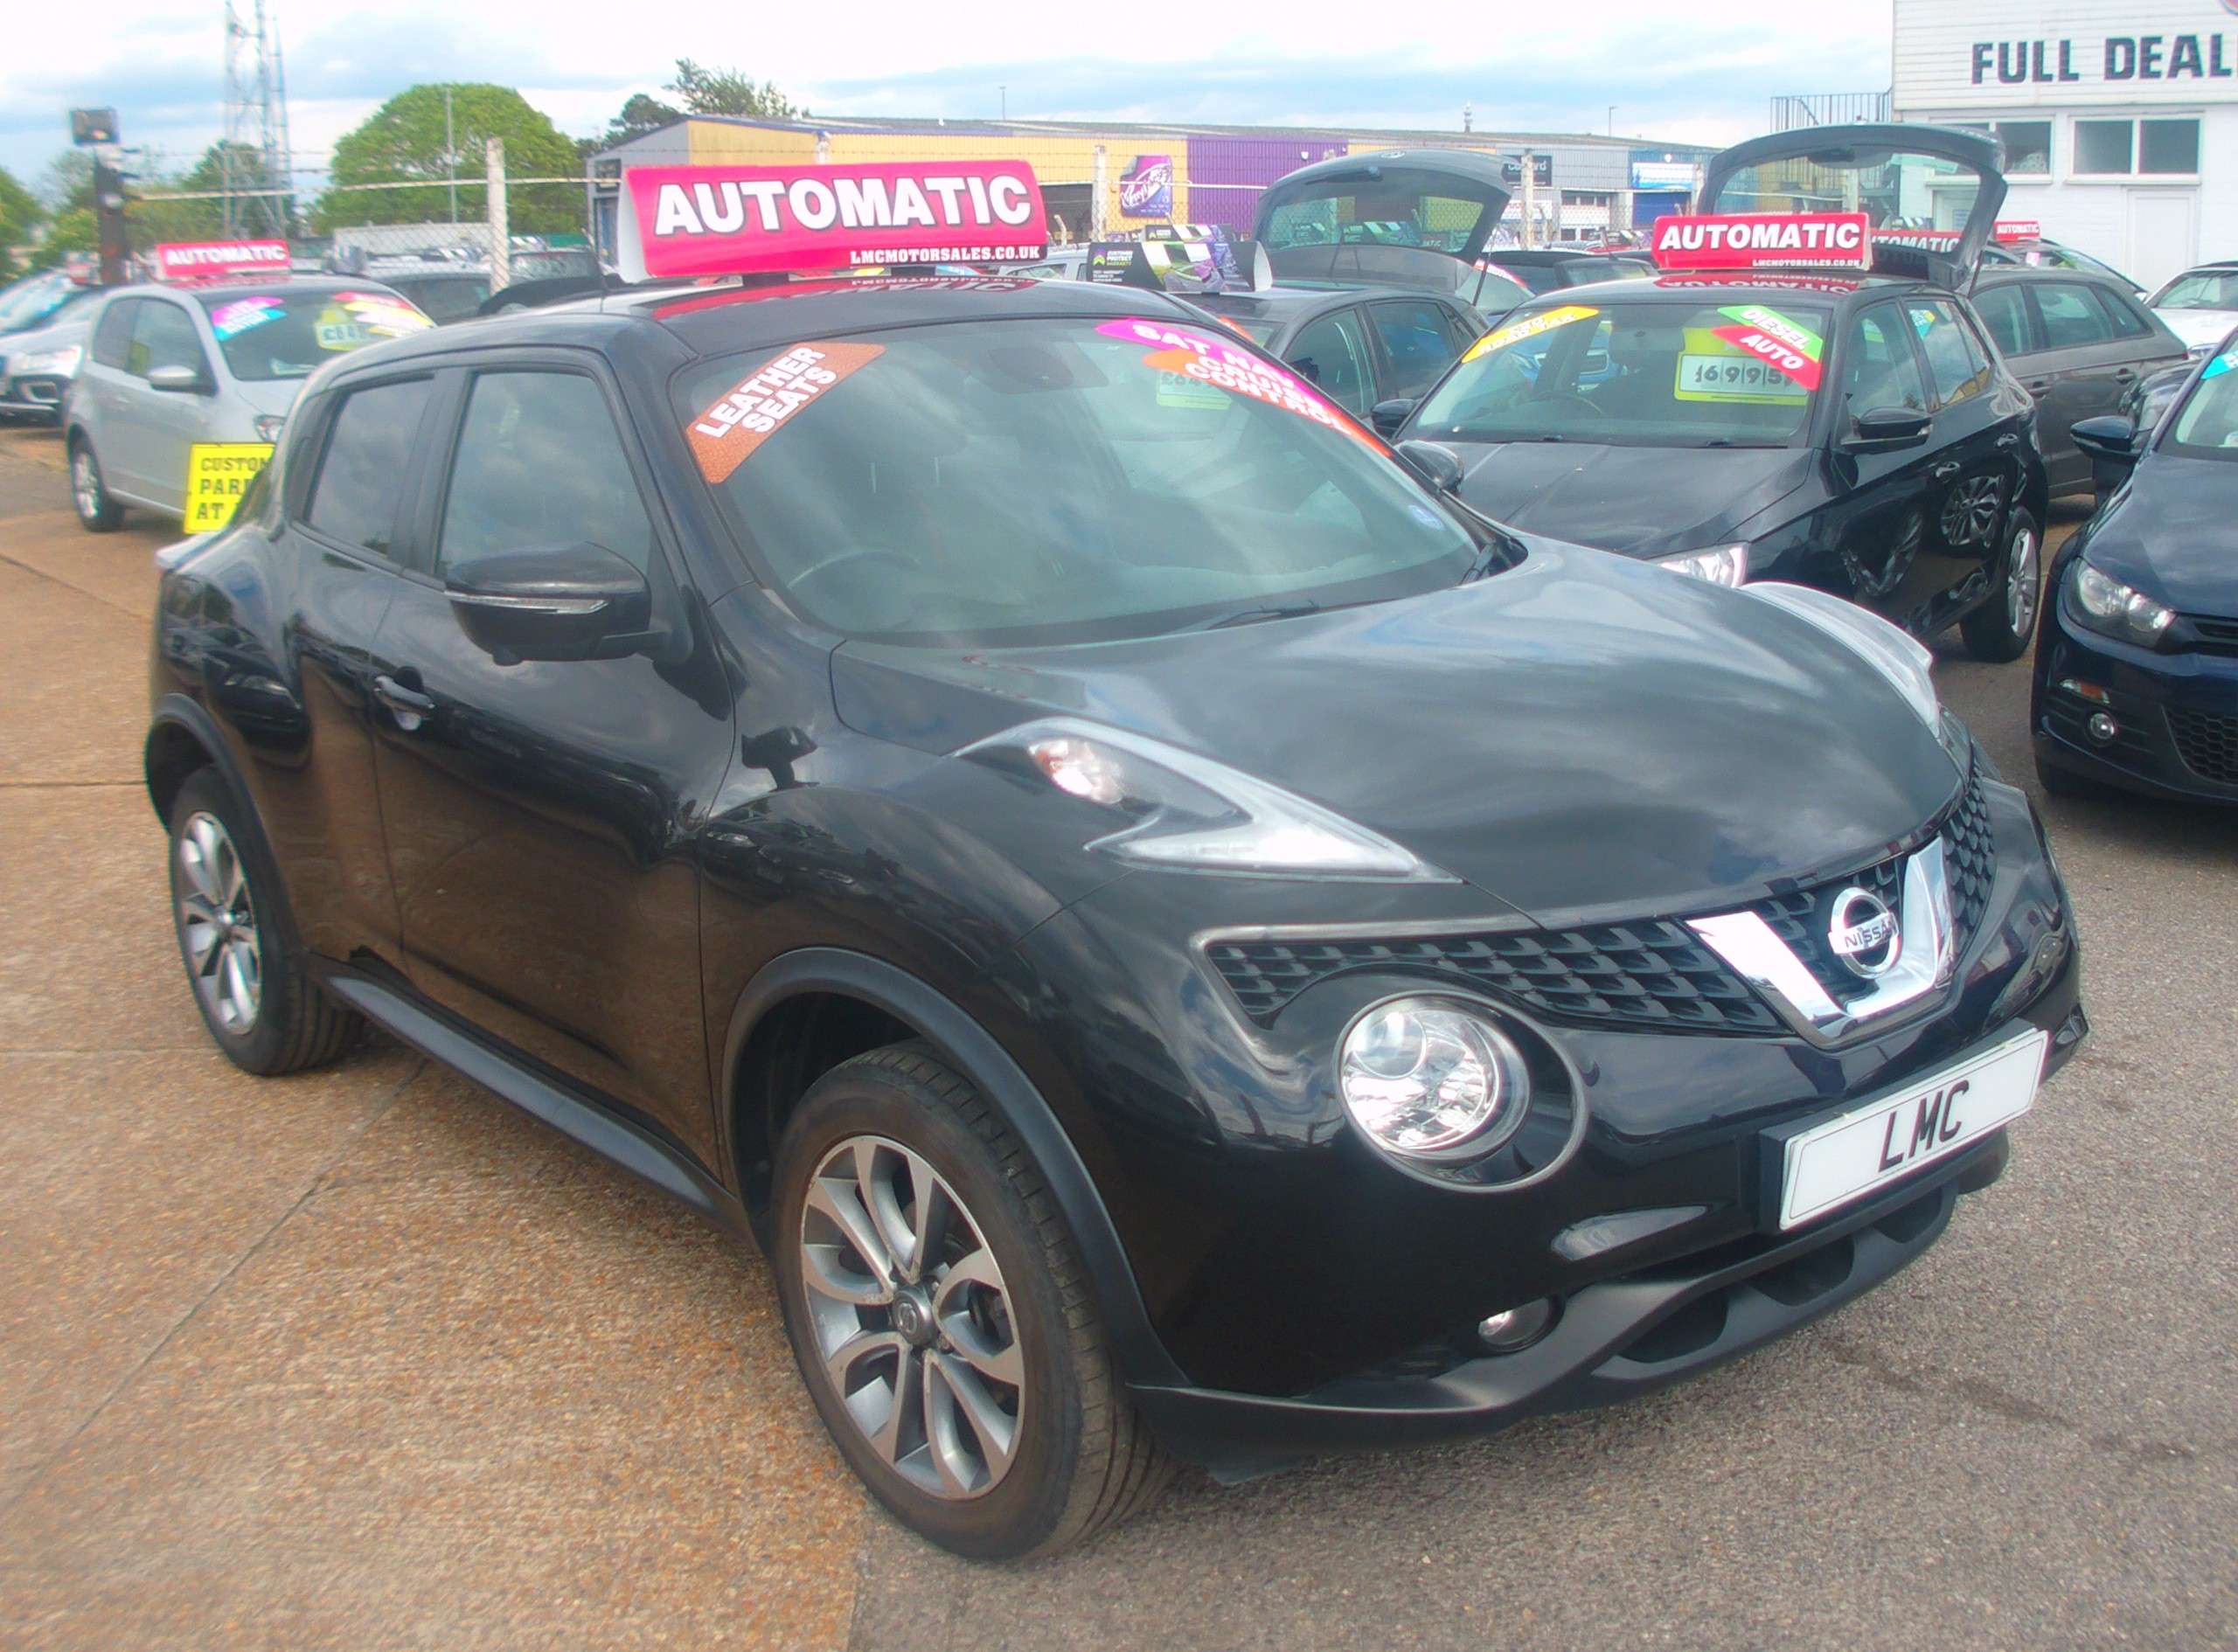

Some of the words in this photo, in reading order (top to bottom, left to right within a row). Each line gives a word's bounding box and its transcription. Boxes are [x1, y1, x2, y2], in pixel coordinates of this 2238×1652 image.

[1970, 39, 2080, 85] FULL
[2102, 33, 2238, 80] DEAL
[653, 174, 1032, 236] AUTOMATIC
[165, 245, 287, 266] AUTOMATIC
[850, 246, 1040, 264] LMCMOTORSALES.CO.UK
[1658, 222, 1860, 251] AUTOMATIC
[1131, 323, 1211, 356] SAT
[1740, 308, 1810, 351] DIESEL
[1739, 334, 1804, 370] AUTO
[695, 347, 826, 438] LEATHER
[741, 366, 837, 433] SEATS
[1185, 362, 1352, 435] CONTROL
[197, 502, 225, 520] AT
[1845, 913, 1898, 948] NISSAN
[1878, 1079, 1970, 1173] LMC
